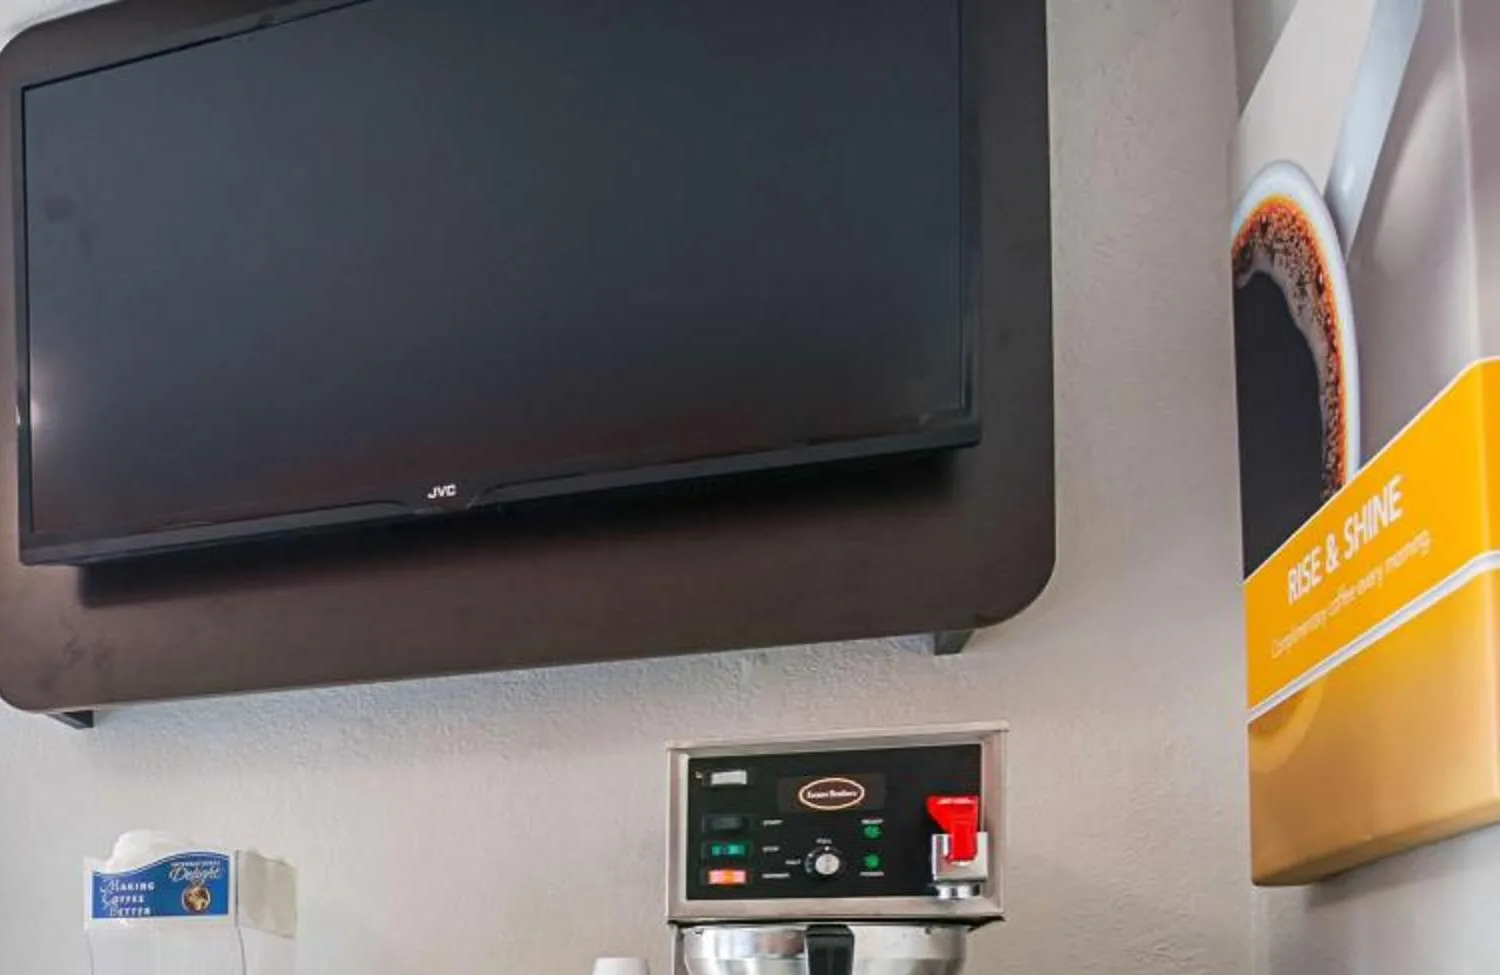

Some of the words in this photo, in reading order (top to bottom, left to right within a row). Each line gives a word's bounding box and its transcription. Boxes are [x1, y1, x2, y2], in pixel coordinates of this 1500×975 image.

[427, 483, 457, 499] JVC
[1288, 546, 1322, 605] RISE
[1326, 533, 1339, 573] &
[1344, 474, 1403, 560] SHINE
[100, 880, 155, 893] MAKING
